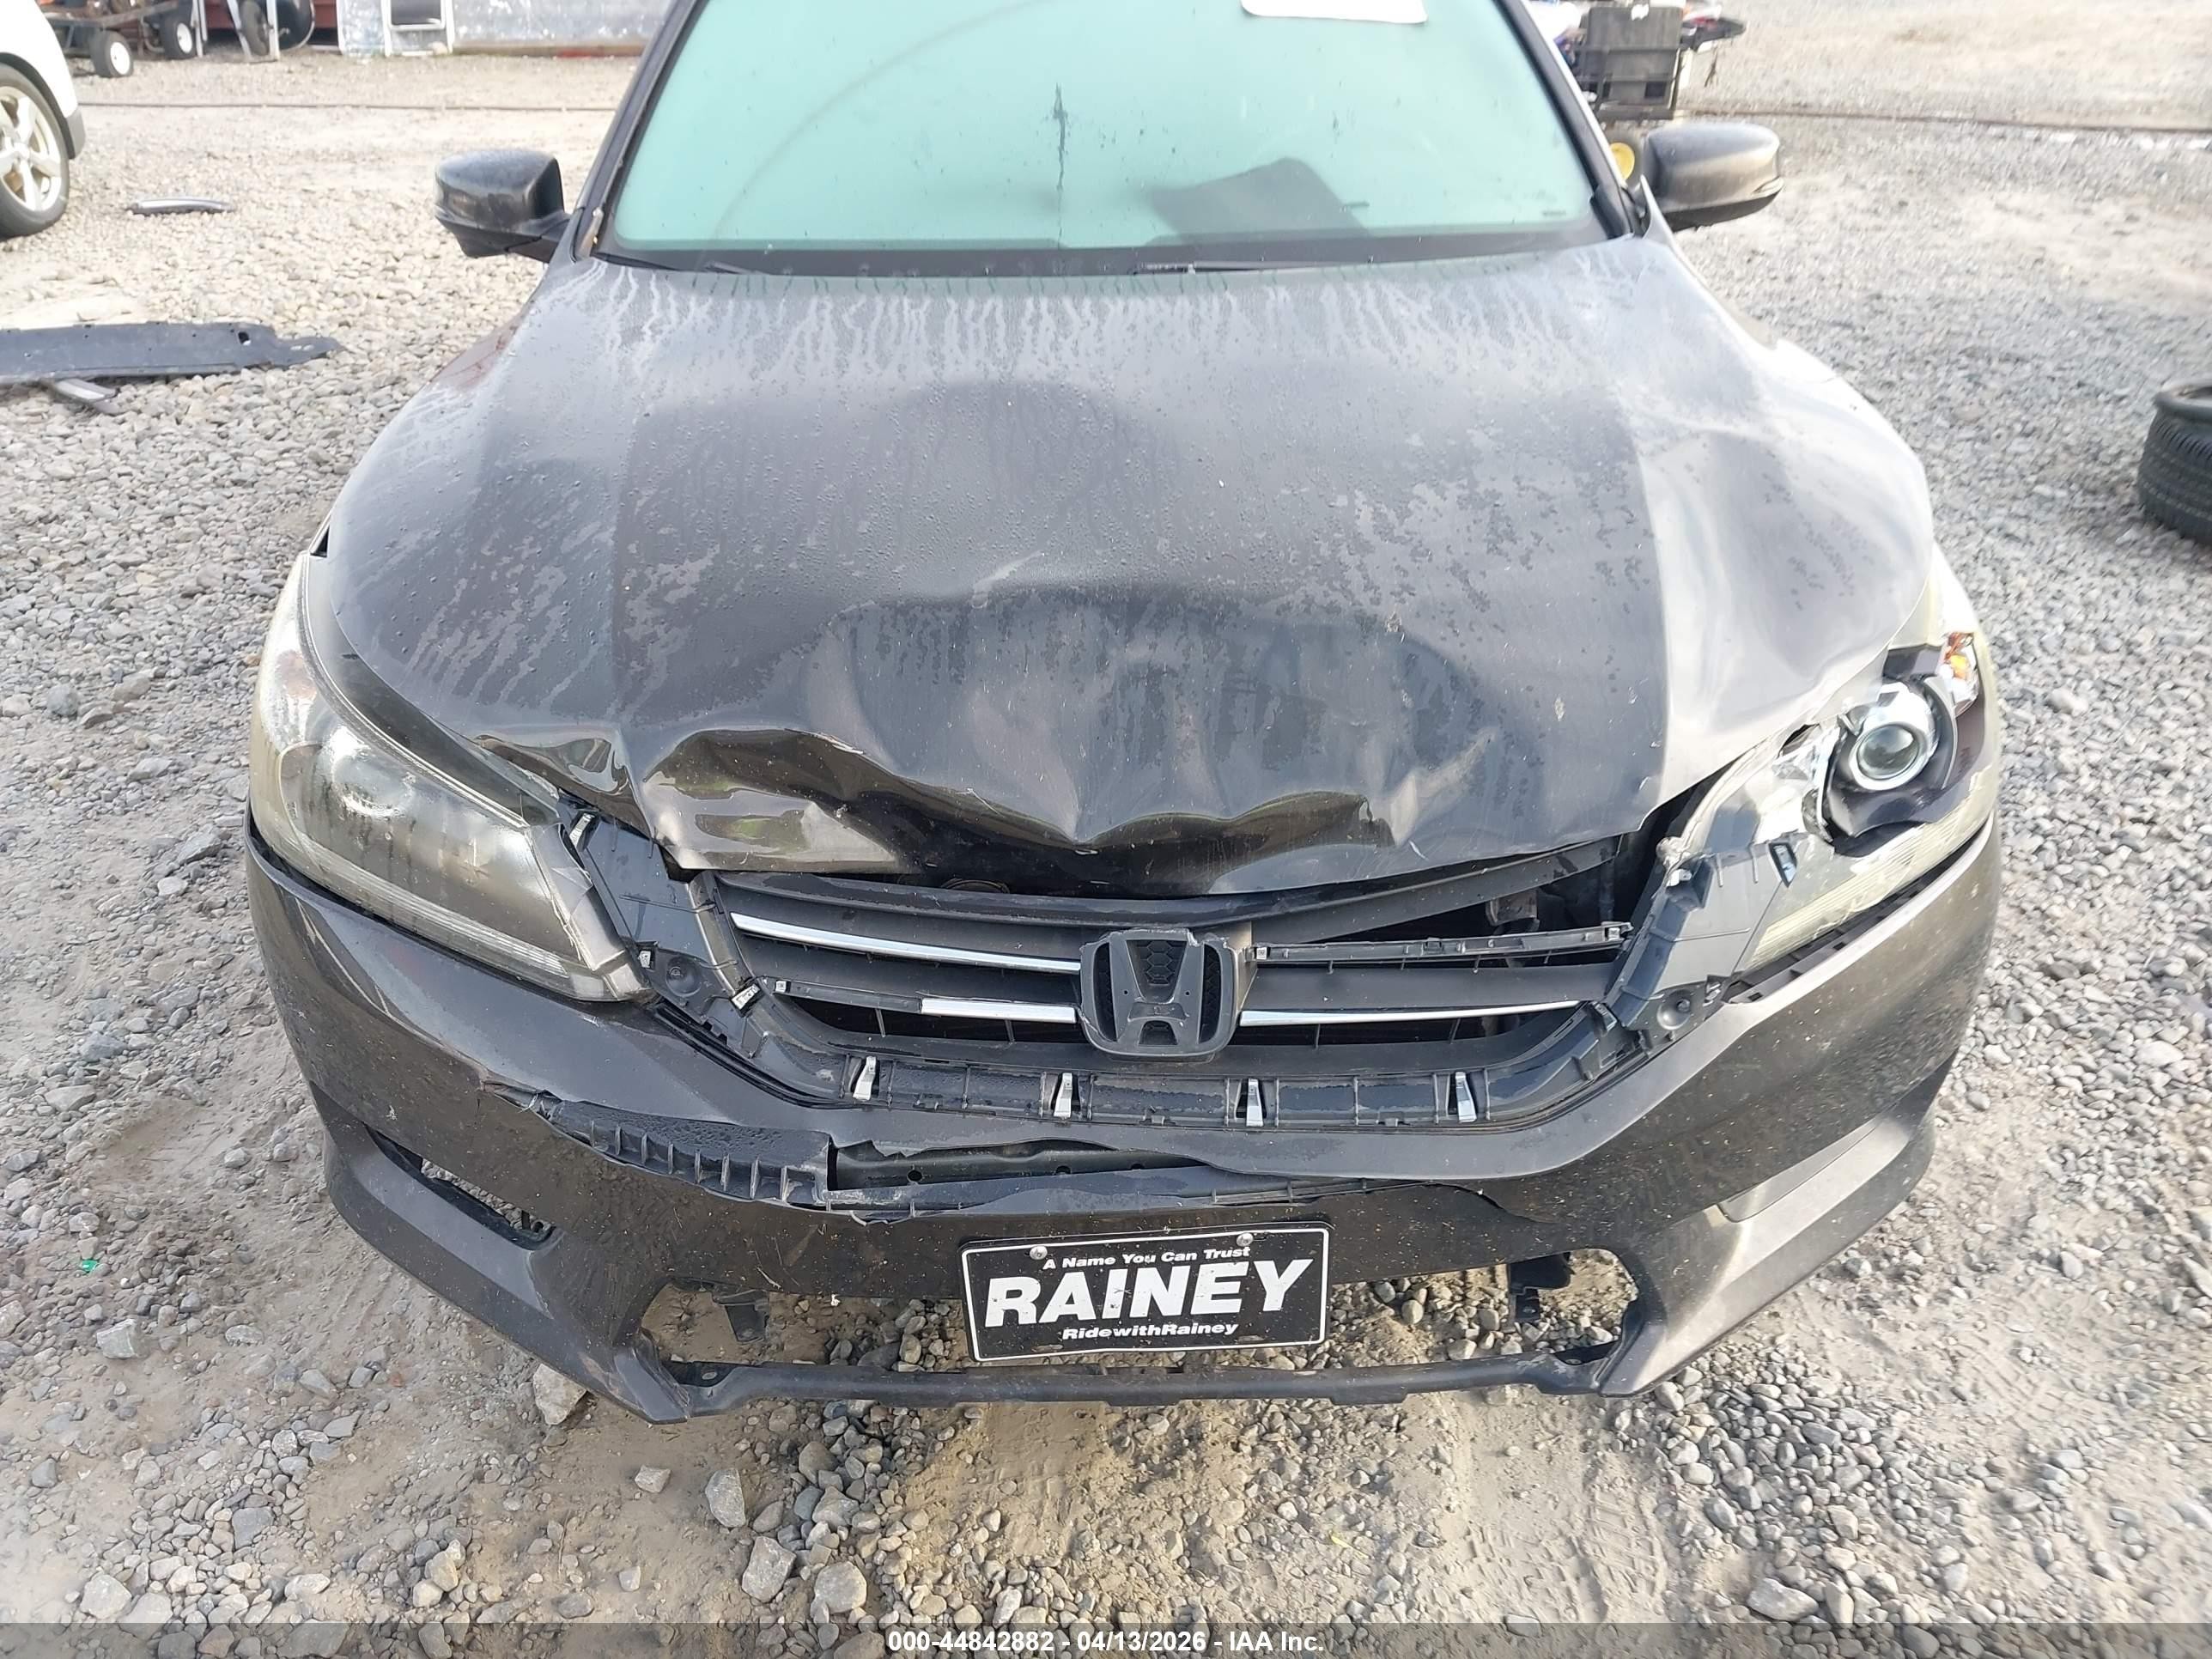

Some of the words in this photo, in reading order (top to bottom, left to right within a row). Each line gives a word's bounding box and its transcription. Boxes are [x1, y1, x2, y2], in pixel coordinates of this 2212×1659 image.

[1042, 1259, 1056, 1270] A
[1061, 1256, 1116, 1268] Name
[1121, 1253, 1157, 1264] You
[1160, 1251, 1198, 1262] Can
[1203, 1246, 1251, 1260] Trust
[984, 1259, 1314, 1328] RAINEY
[1061, 1323, 1239, 1341] RidewithRainey
